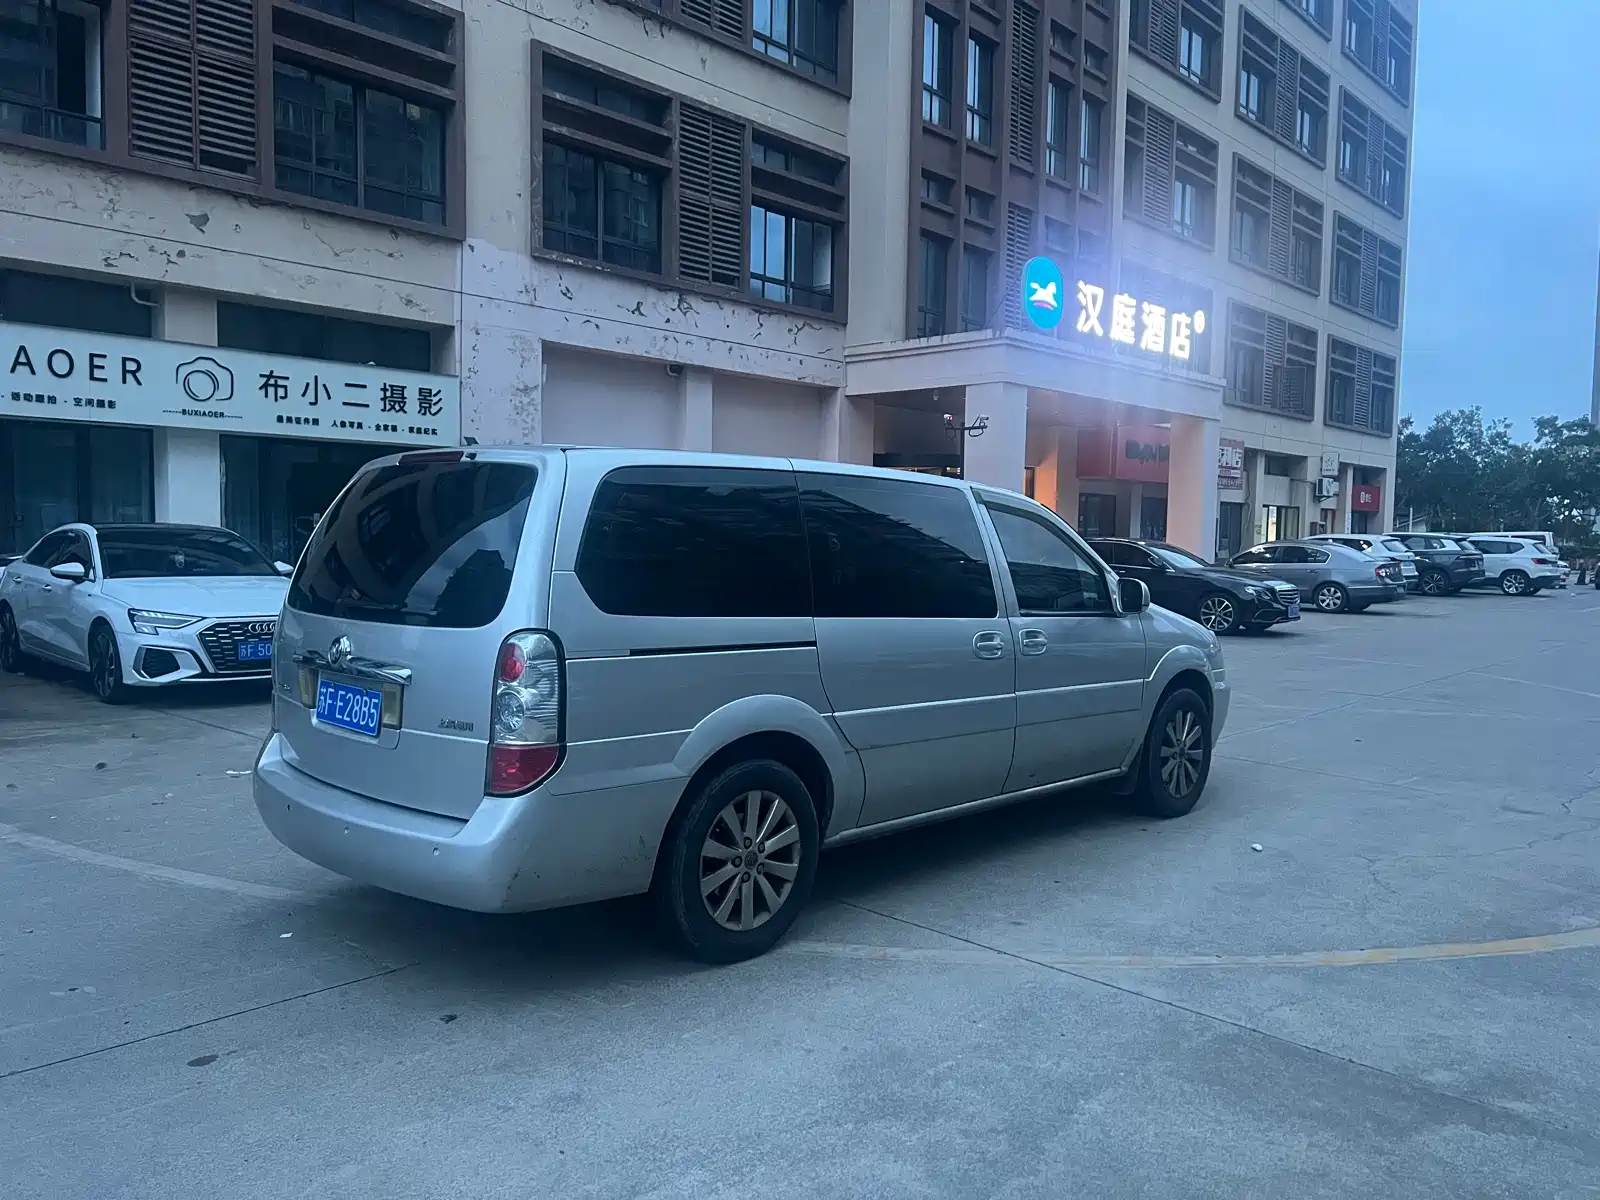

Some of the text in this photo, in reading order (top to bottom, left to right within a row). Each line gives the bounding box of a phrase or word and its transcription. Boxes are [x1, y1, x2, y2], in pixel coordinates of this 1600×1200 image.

[1076, 280, 1192, 361] 汉庭酒店
[9, 344, 143, 387] AOER
[181, 408, 225, 419] BUXIAOER
[258, 369, 443, 416] 布小二摄影
